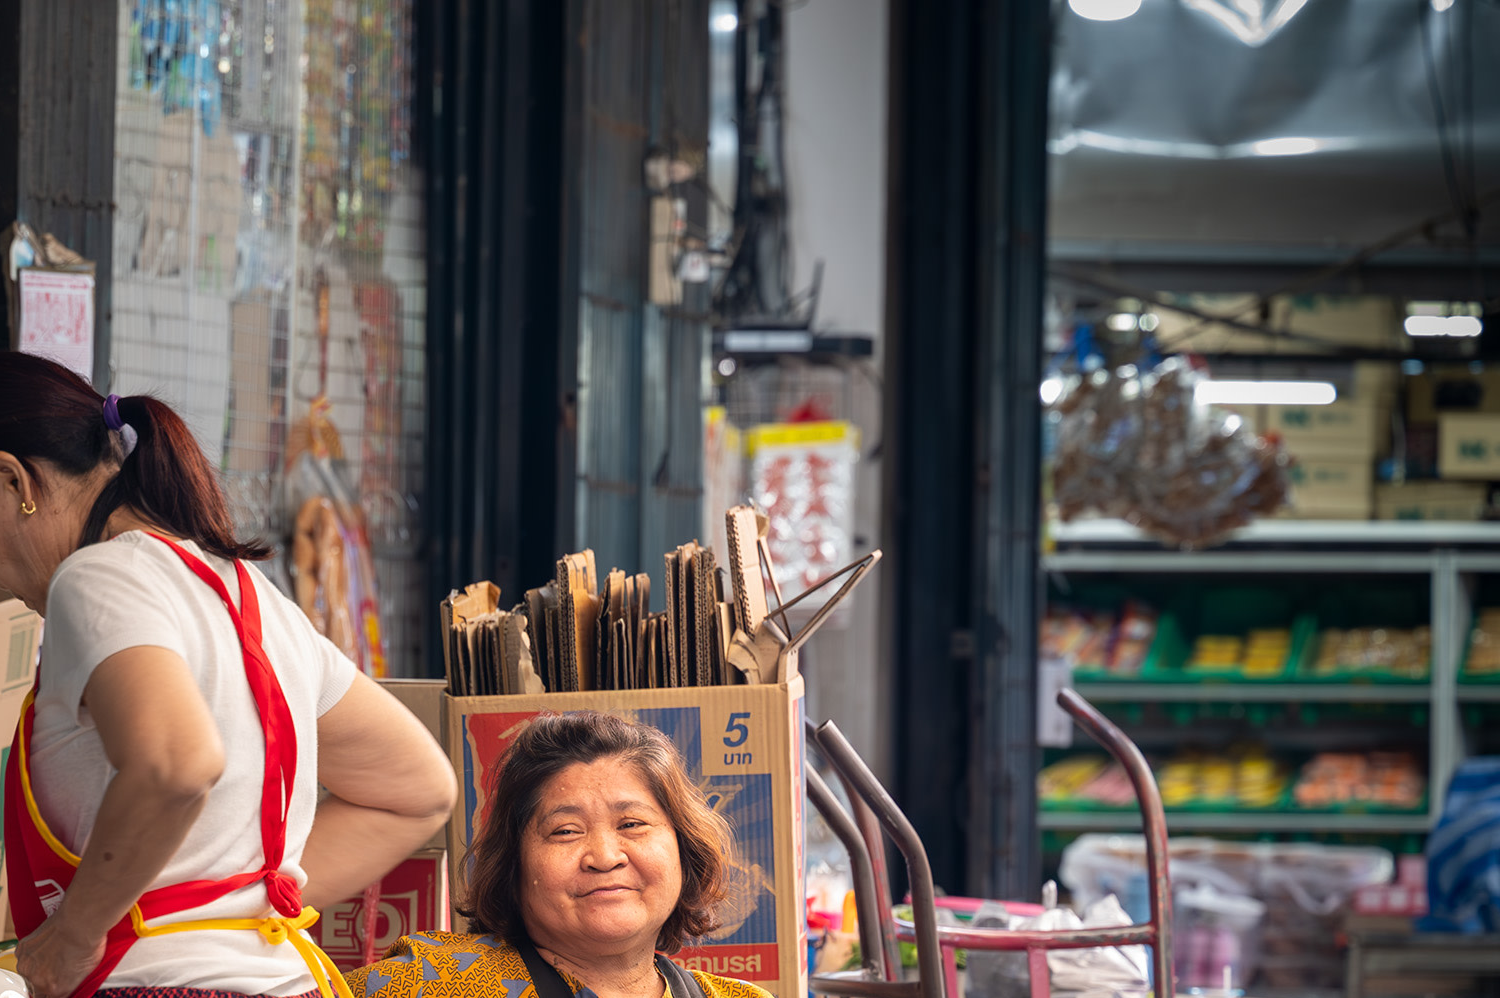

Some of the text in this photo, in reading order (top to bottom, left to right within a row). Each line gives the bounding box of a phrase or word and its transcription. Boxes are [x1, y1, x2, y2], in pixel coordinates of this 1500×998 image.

[722, 711, 752, 748] 5
[723, 752, 753, 766] บาท
[313, 900, 402, 950] EO
